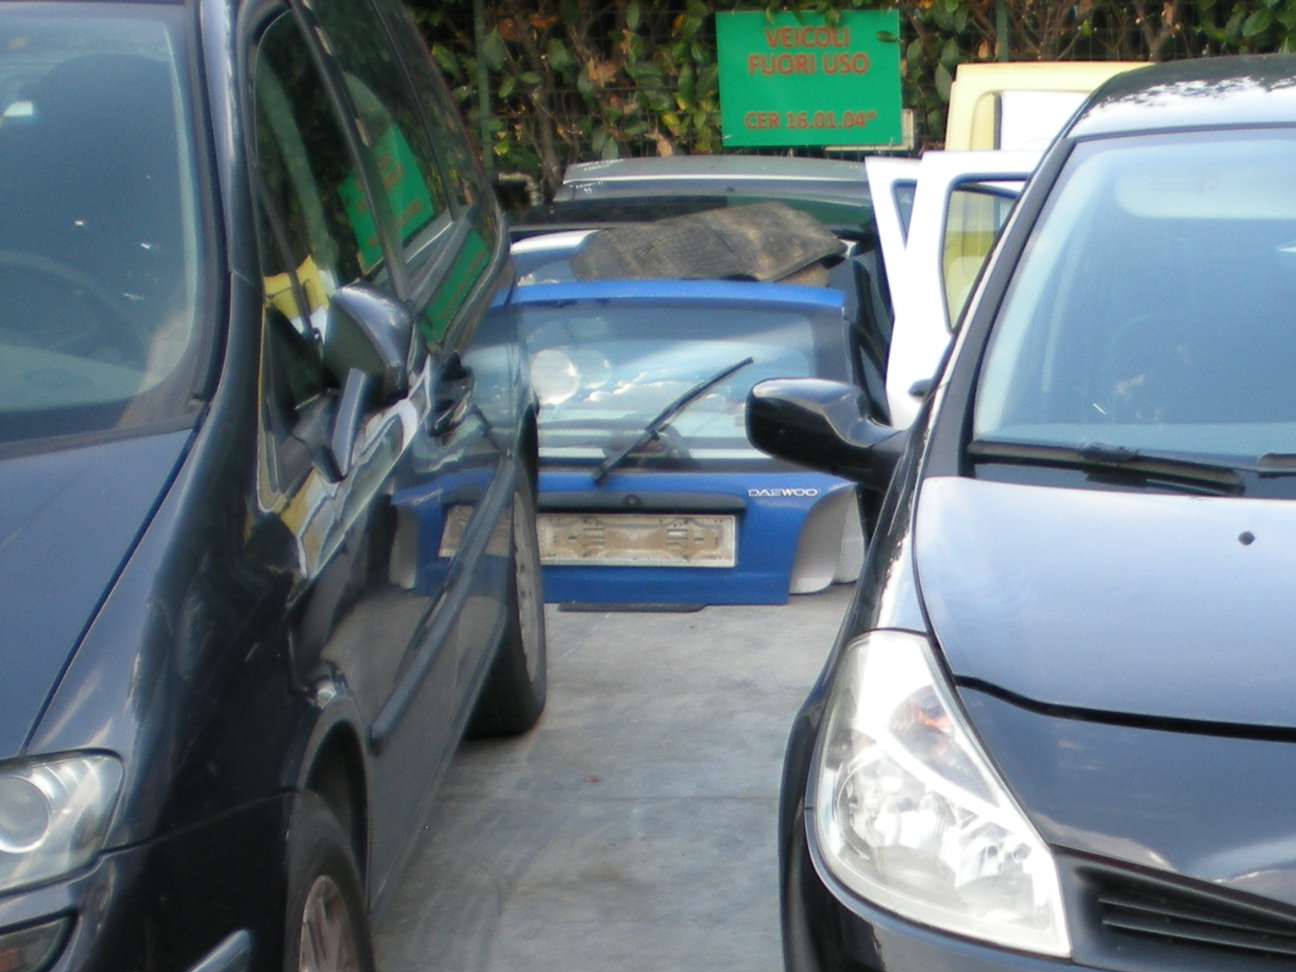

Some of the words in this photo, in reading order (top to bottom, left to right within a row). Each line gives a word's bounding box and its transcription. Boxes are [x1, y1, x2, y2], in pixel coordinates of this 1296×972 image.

[765, 27, 849, 47] VEICOLI
[748, 54, 816, 75] FUORI
[823, 53, 869, 74] USO
[745, 112, 779, 129] CER
[747, 488, 818, 497] DAEWOO
